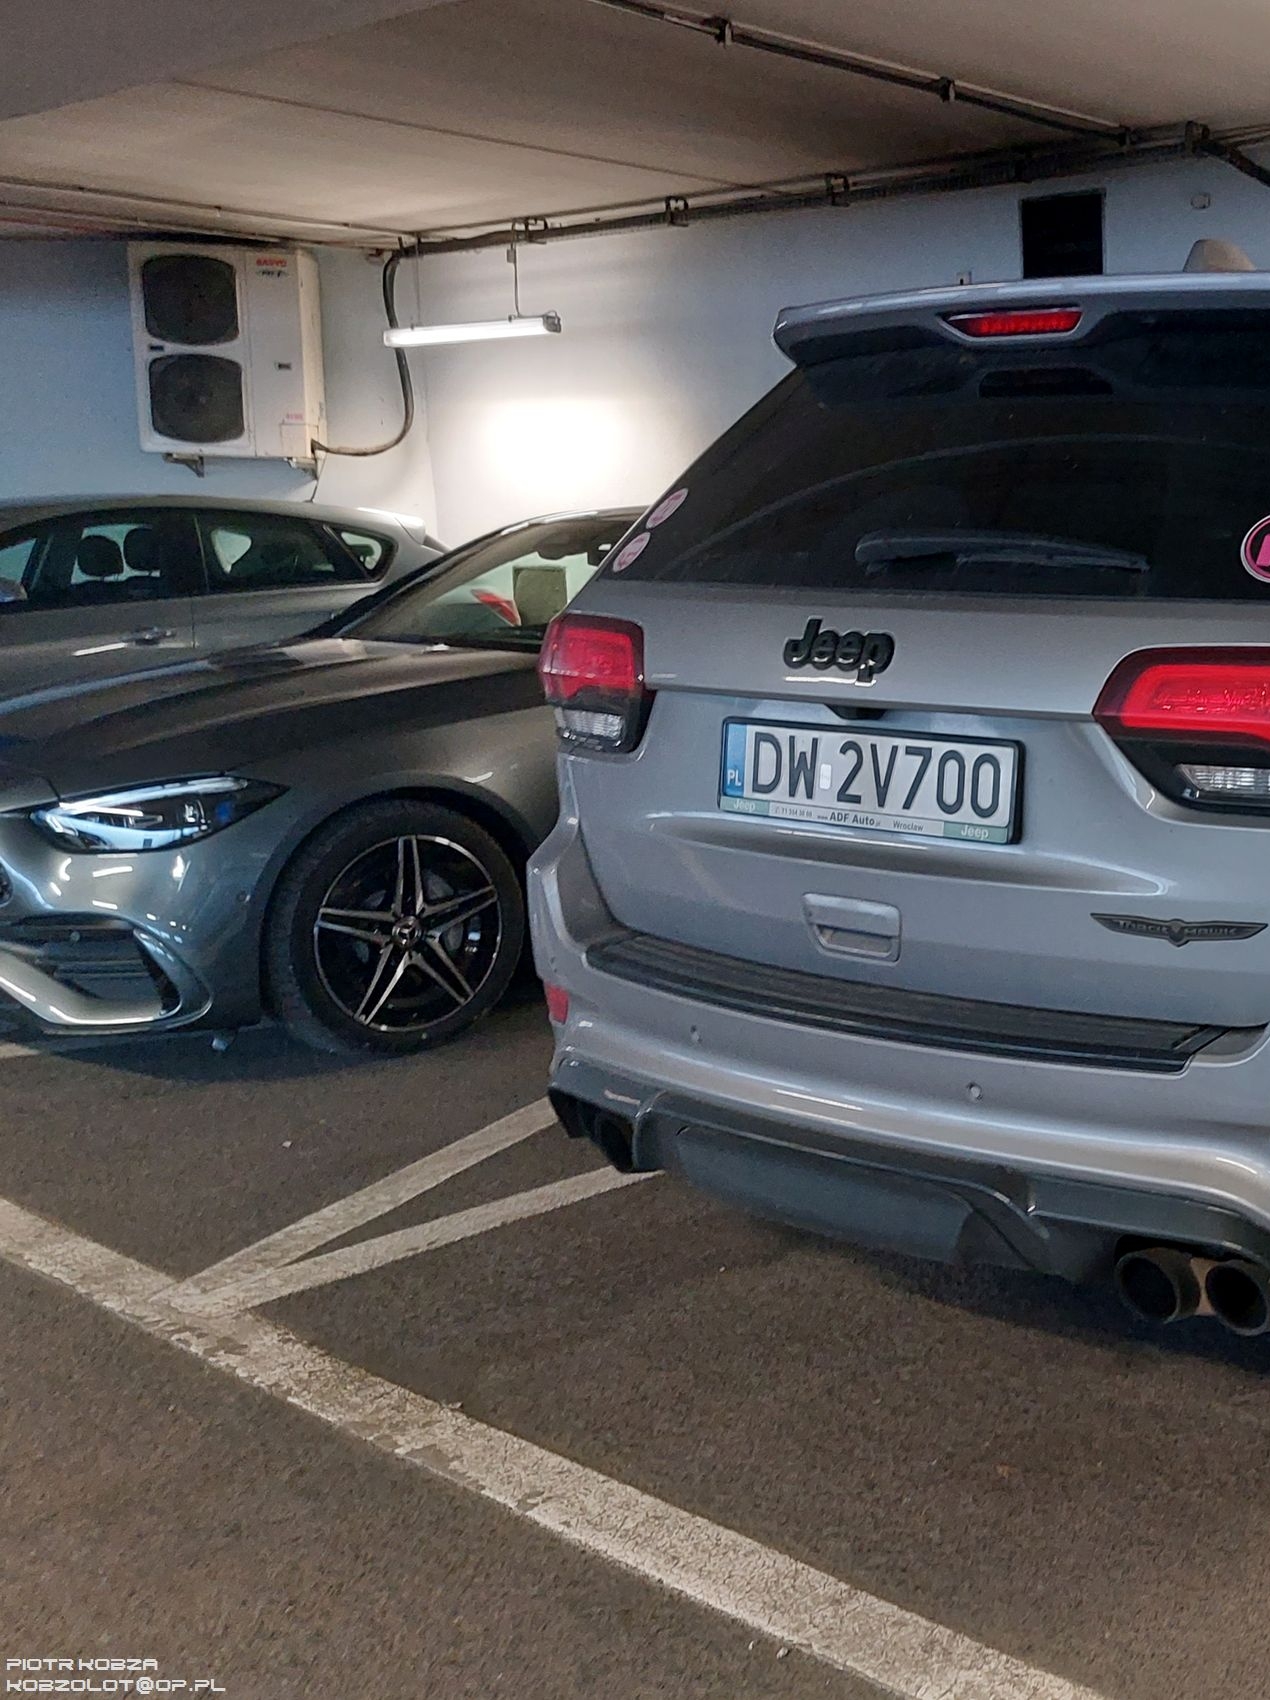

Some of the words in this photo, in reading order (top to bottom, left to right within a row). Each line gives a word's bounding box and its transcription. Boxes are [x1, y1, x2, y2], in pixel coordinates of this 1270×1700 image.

[783, 616, 896, 684] Jeep
[727, 769, 742, 786] PL
[752, 732, 818, 799] DW
[836, 740, 1001, 818] 2V700
[733, 799, 756, 812] Jeep
[829, 812, 849, 822] ADF
[961, 825, 989, 840] Jeep
